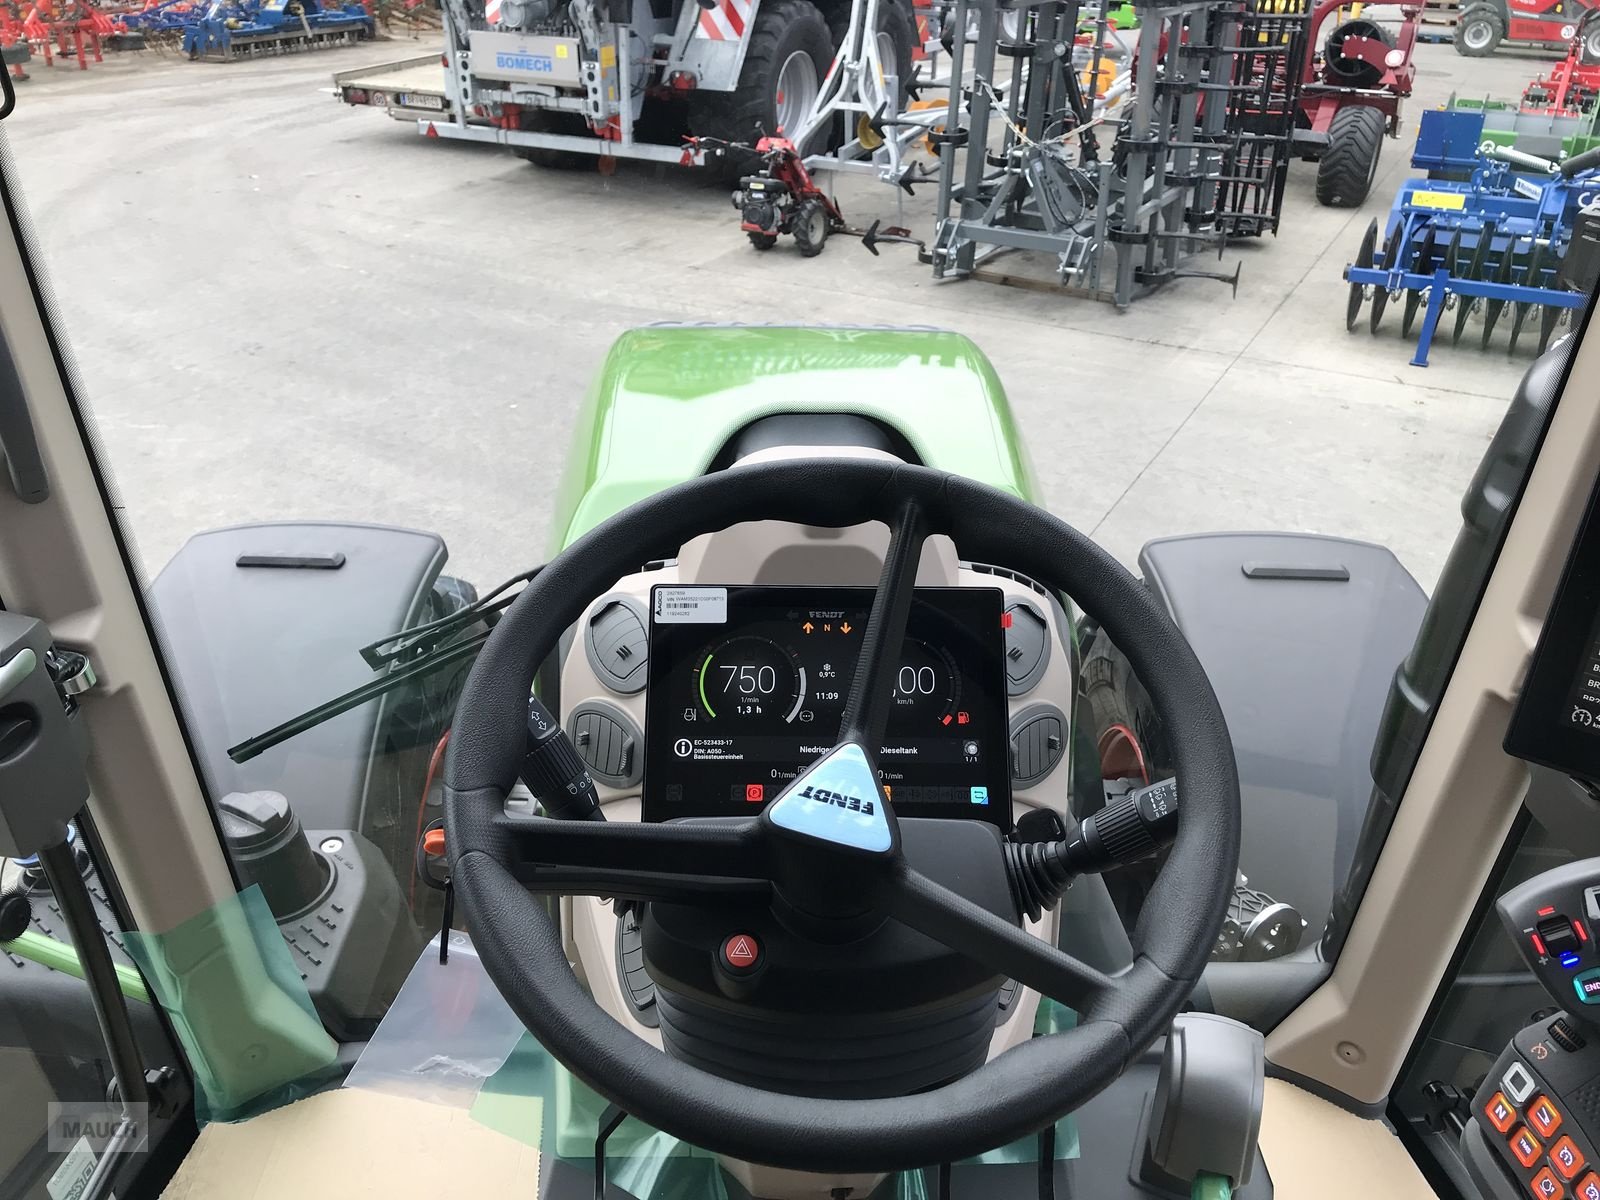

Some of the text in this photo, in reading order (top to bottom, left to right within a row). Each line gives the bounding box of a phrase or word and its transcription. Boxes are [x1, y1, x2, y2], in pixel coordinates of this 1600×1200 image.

[496, 56, 552, 72] BOMECH
[823, 624, 831, 632] N
[719, 665, 776, 694] 750
[815, 692, 839, 700] 11:09
[880, 746, 918, 754] Dieseltank
[797, 785, 875, 816] FENDT
[1495, 1104, 1506, 1119] N
[1520, 1138, 1533, 1155] TMS
